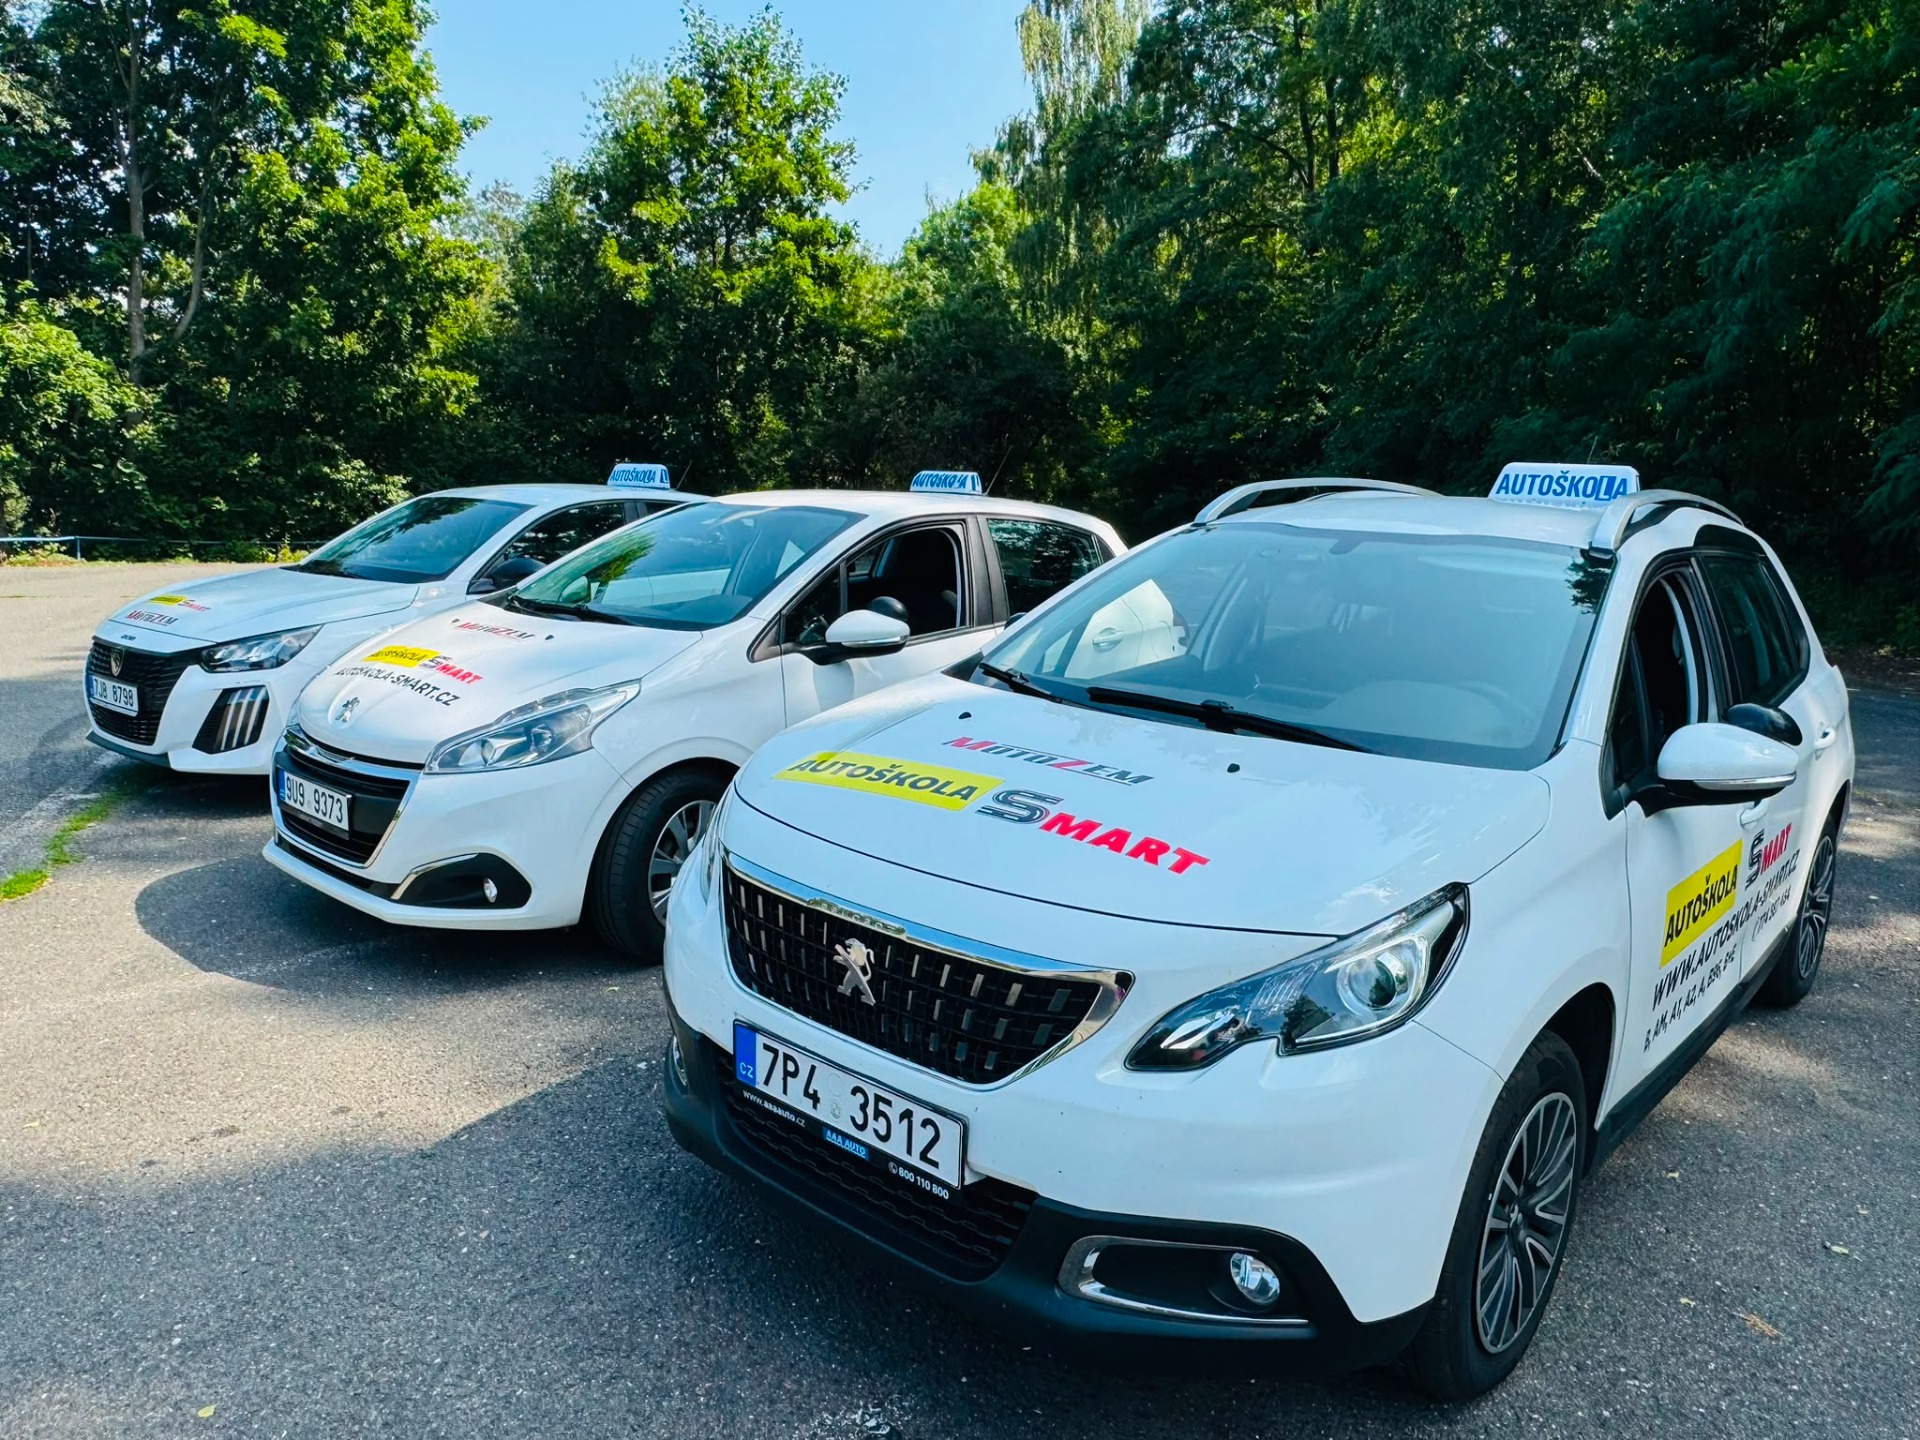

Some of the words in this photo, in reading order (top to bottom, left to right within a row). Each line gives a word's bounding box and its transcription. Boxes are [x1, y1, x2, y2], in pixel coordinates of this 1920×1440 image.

[1495, 470, 1628, 501] AUTOŠKOLA
[418, 655, 484, 686] SMART
[112, 684, 134, 707] 8798
[286, 776, 305, 808] 9U9
[313, 788, 343, 824] 9373
[787, 757, 979, 803] AUTOŠKOLA
[975, 788, 1211, 875] SMART
[1664, 864, 1739, 948] AUTOŠKOLA
[1744, 823, 1793, 892] SMART
[1652, 848, 1801, 1012] WWW.AUTOSKOLA-SMART.CZ
[739, 1062, 754, 1079] CZ
[762, 1042, 821, 1111] 7P4
[850, 1085, 941, 1170] 3512
[742, 1089, 806, 1128] www.aaaauto.cz
[825, 1129, 843, 1146] AAA
[844, 1140, 866, 1156] AUTO
[898, 1166, 915, 1182] 800
[916, 1176, 931, 1191] 110
[932, 1184, 949, 1200] 800
